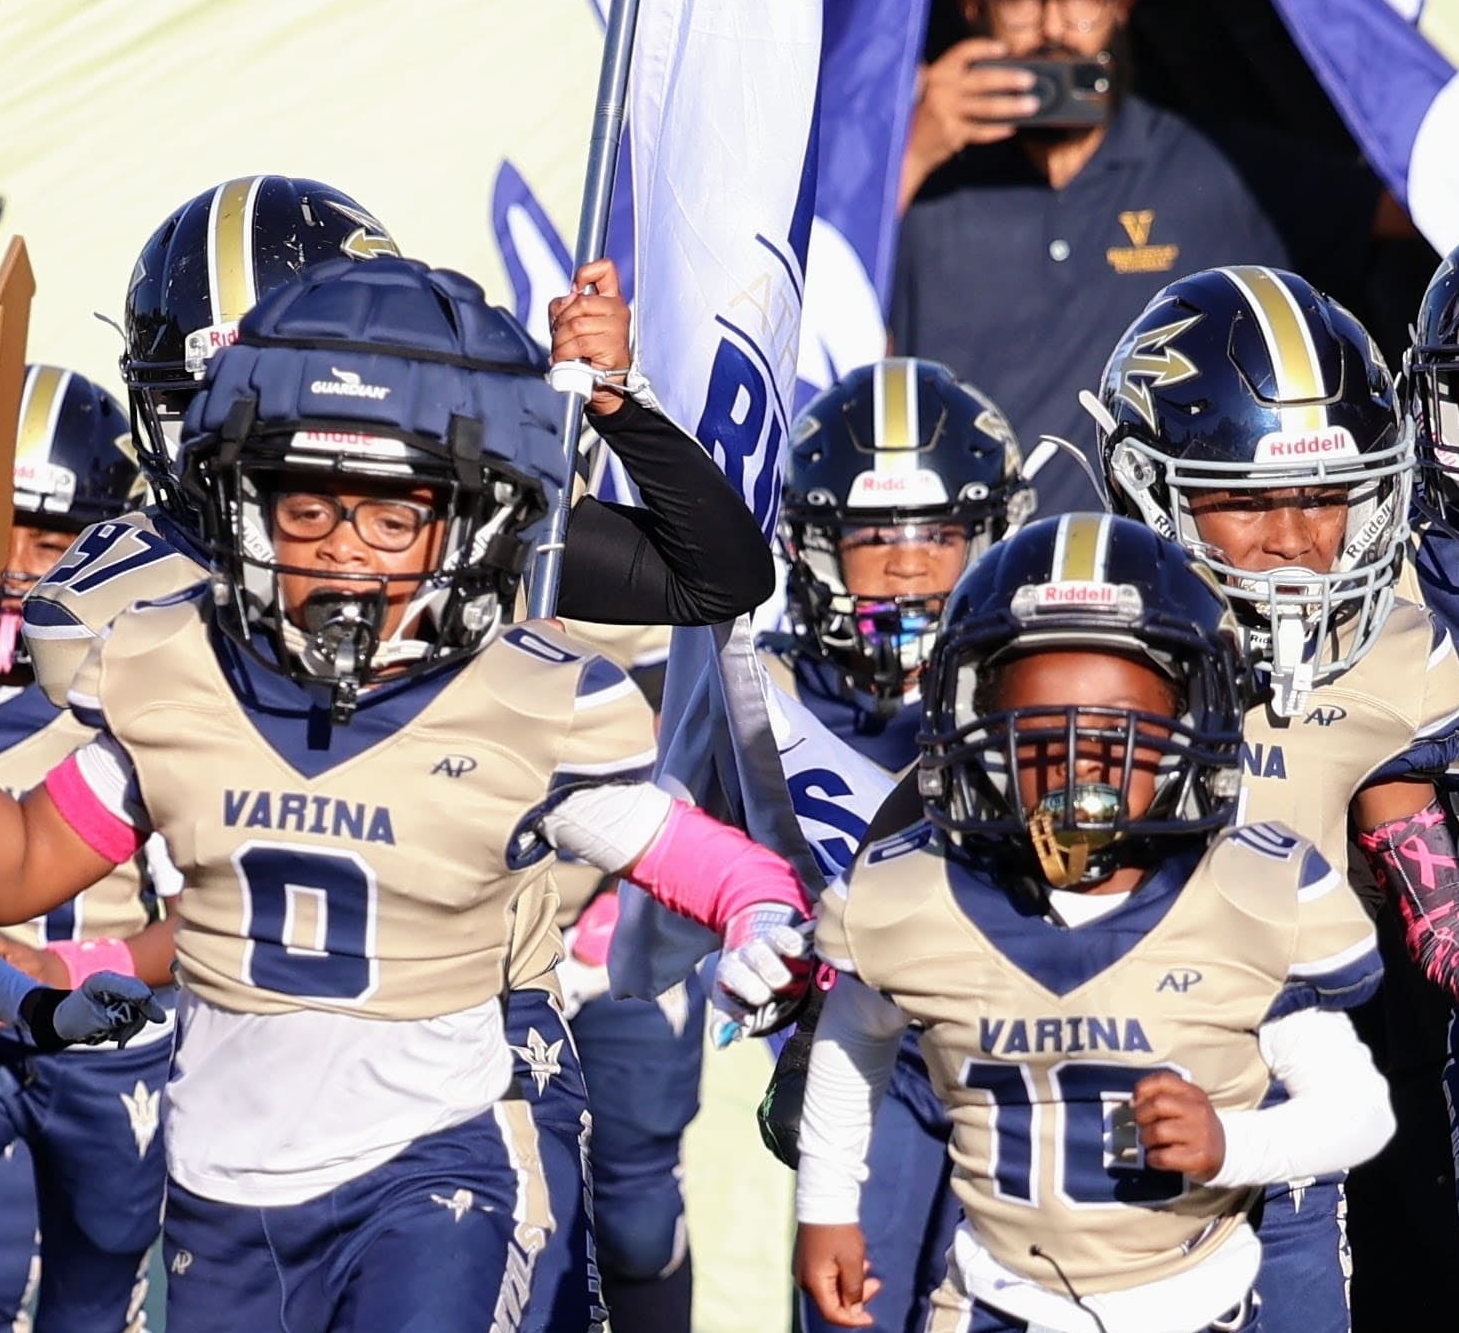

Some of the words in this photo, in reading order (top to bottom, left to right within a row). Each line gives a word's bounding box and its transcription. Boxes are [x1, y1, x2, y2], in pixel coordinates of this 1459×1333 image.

[1269, 434, 1346, 457] Riddell
[1044, 585, 1114, 604] Riddell
[222, 788, 396, 847] VARINA
[232, 840, 379, 1004] 0
[979, 1016, 1154, 1055] VARINA
